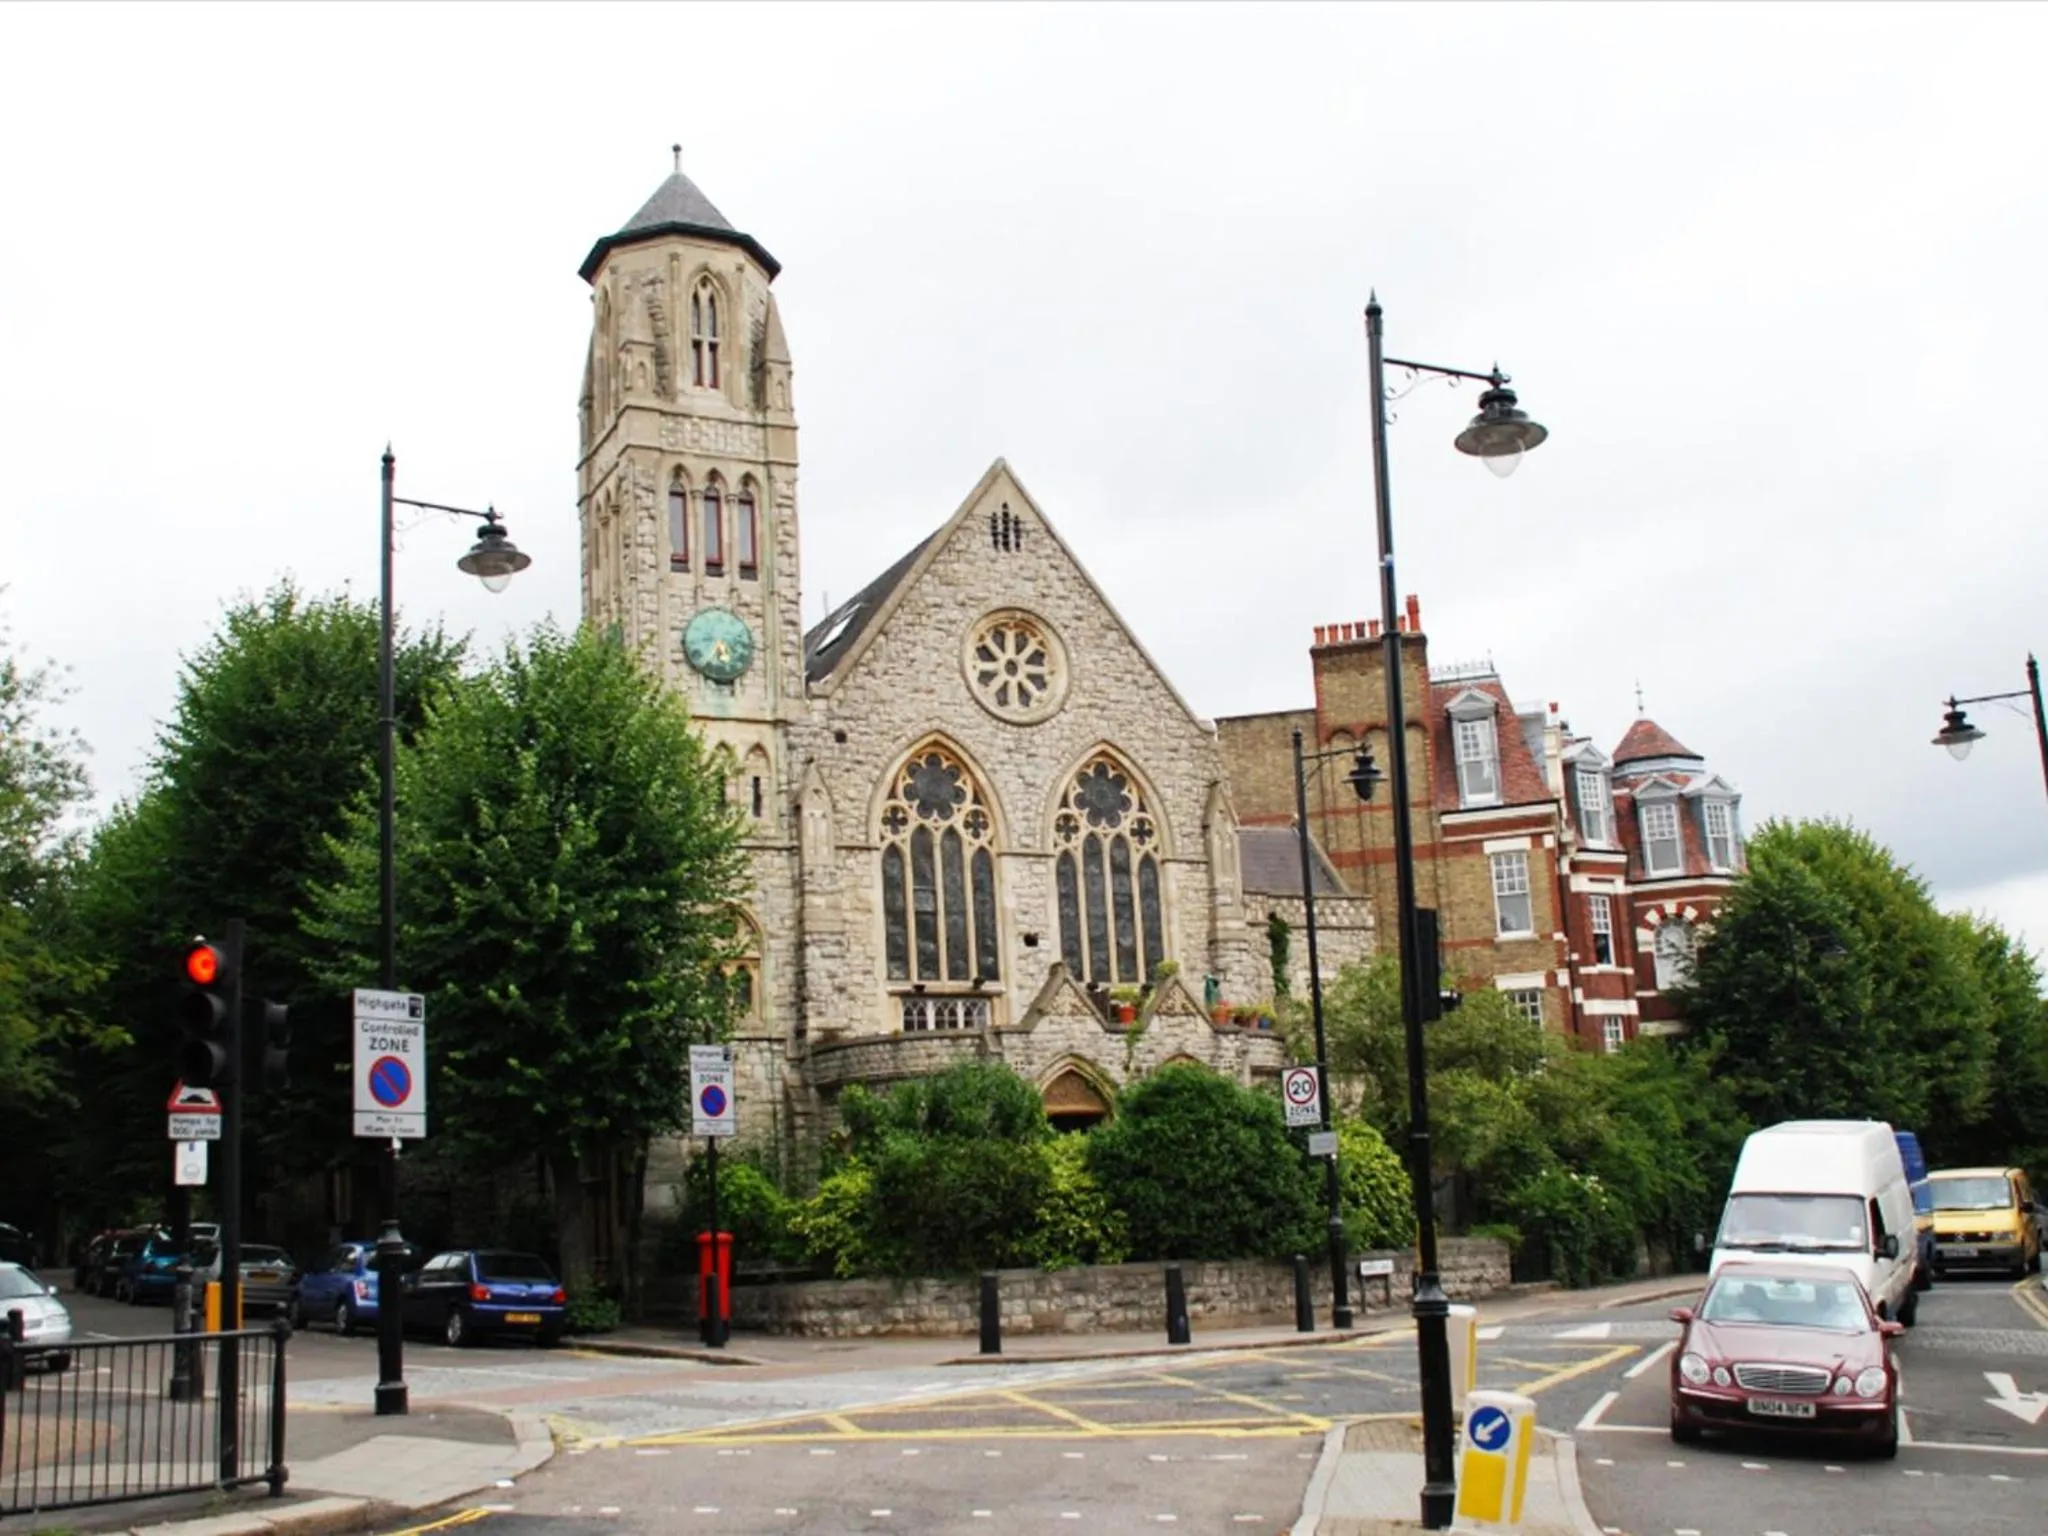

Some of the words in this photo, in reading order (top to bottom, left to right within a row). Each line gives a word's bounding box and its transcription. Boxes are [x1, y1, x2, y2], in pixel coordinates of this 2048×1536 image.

[357, 996, 406, 1011] Highgate
[361, 1021, 419, 1036] Controlled
[369, 1036, 411, 1053] ZONE
[1291, 1080, 1311, 1095] 20
